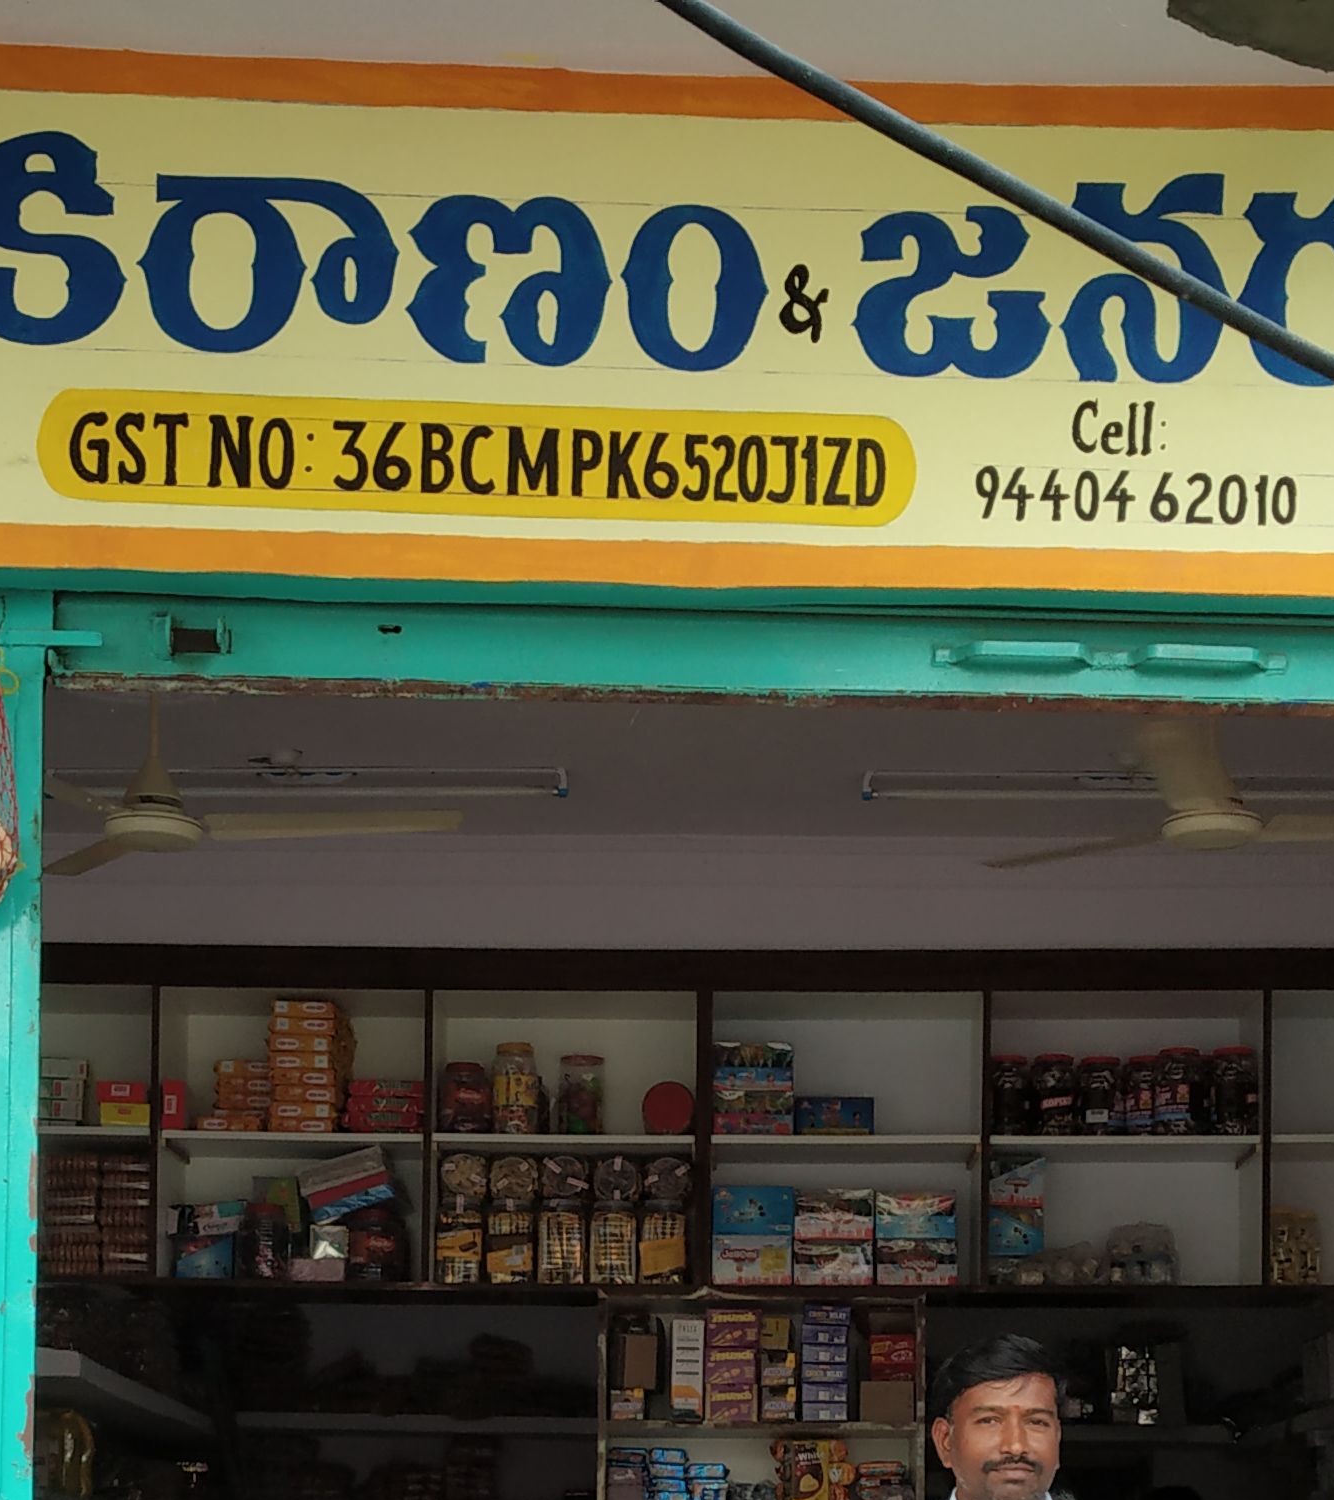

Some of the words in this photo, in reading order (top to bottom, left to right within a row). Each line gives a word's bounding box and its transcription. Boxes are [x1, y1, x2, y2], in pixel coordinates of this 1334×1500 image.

[778, 263, 831, 343] &
[68, 411, 190, 487] GST
[1071, 397, 1168, 457] Cell:
